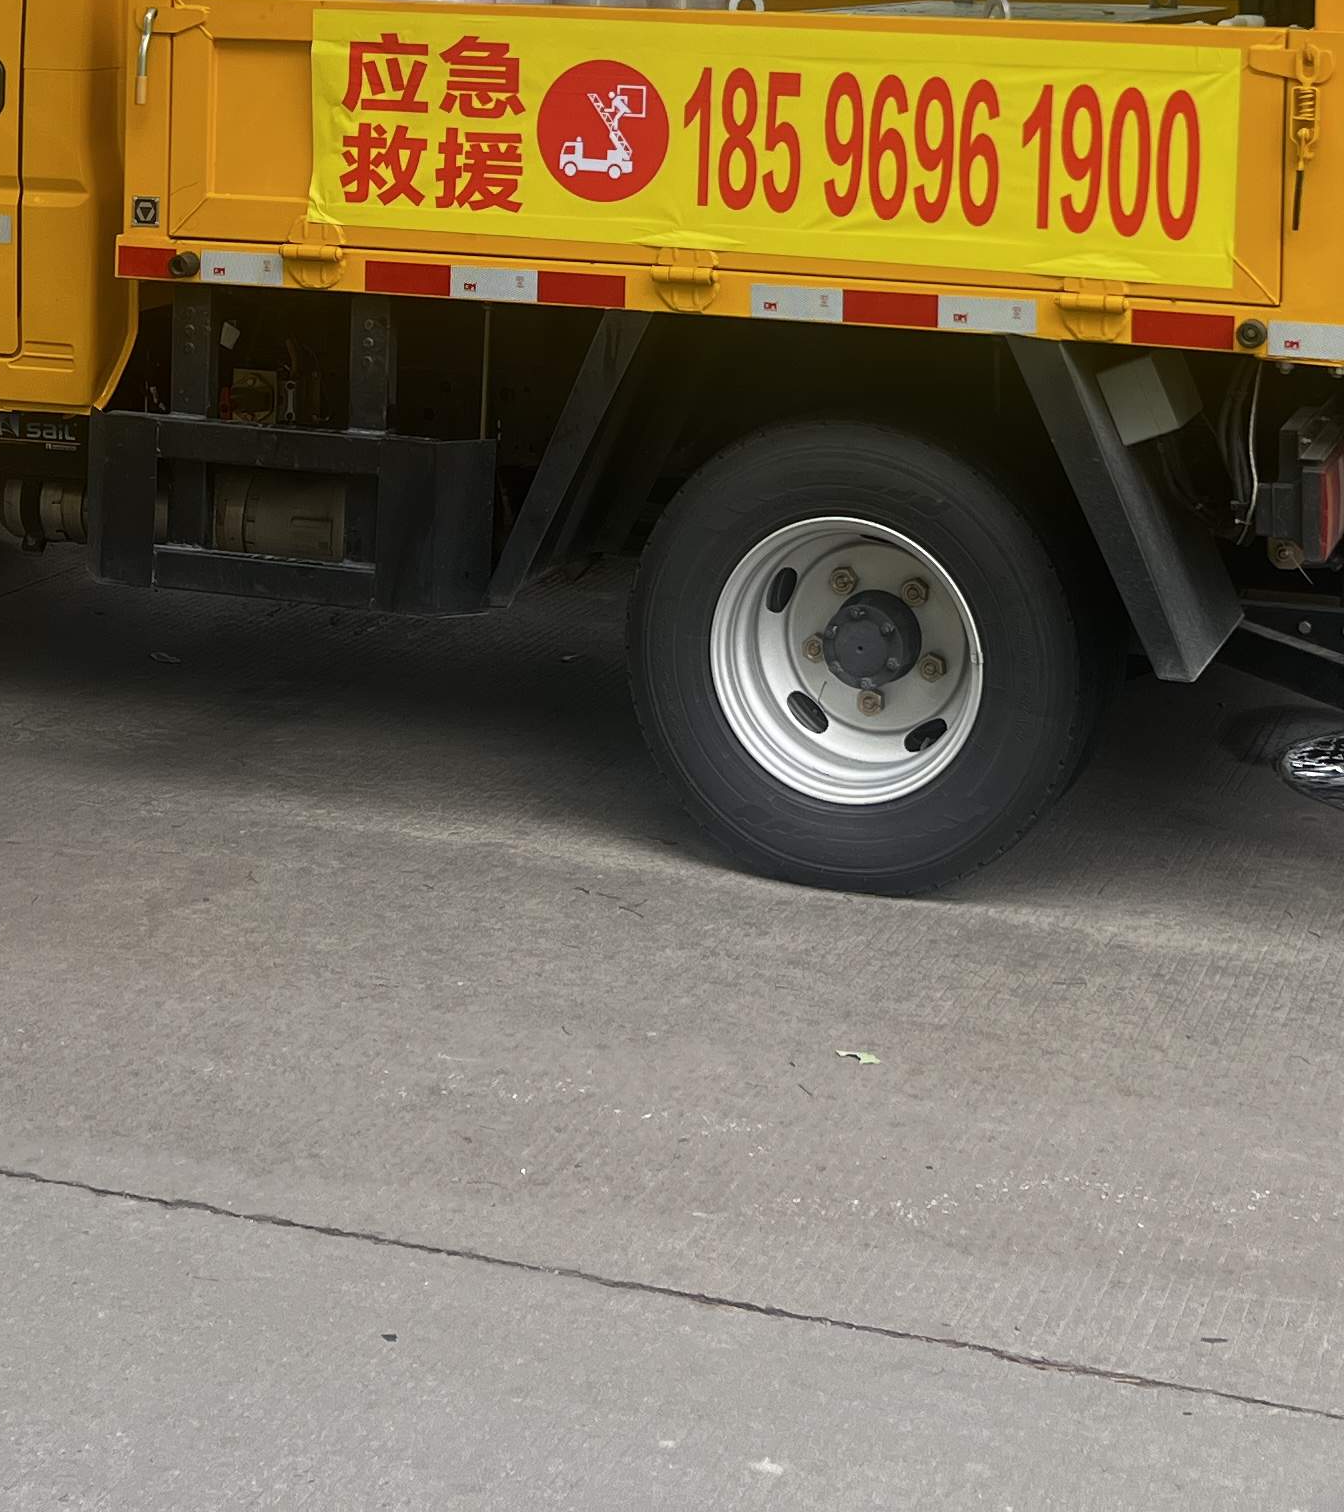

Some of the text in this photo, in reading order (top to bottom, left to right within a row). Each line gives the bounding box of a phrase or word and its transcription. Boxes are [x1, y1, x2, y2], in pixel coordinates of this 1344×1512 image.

[341, 33, 526, 120] 应急
[339, 123, 525, 213] 救援
[683, 67, 802, 213] 185
[824, 72, 1000, 227] 9696
[1022, 84, 1200, 241] 1900
